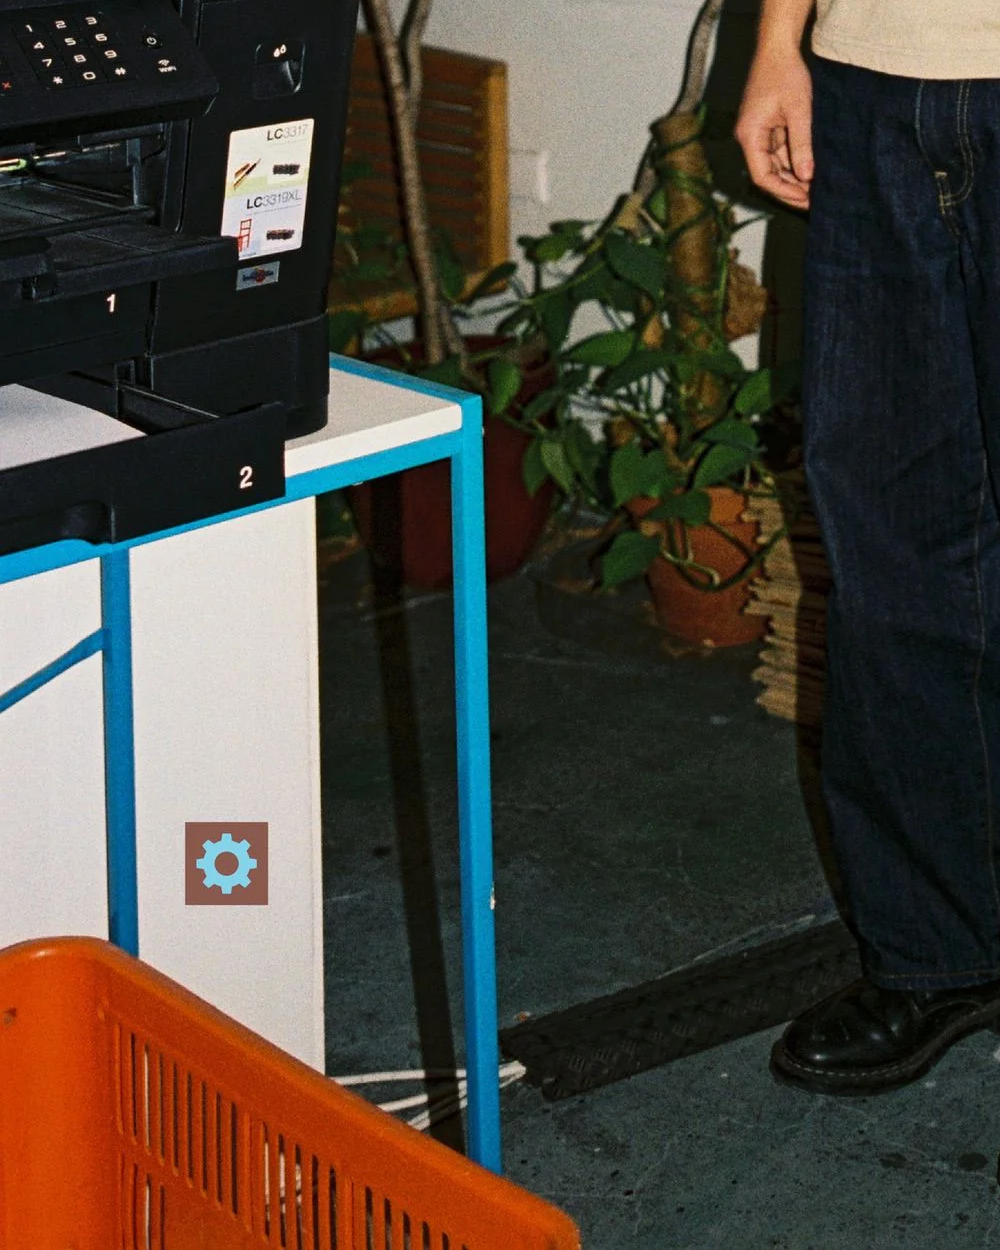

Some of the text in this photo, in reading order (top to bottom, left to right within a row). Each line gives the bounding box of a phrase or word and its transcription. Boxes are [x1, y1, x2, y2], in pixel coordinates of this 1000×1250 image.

[55, 20, 67, 29] 2
[85, 16, 98, 25] 3
[33, 33, 108, 50] 4 5 6
[41, 50, 118, 68] 7 8 9
[82, 71, 97, 81] 0
[266, 124, 309, 141] LC3317
[106, 293, 116, 313] 1
[239, 465, 253, 489] 2
